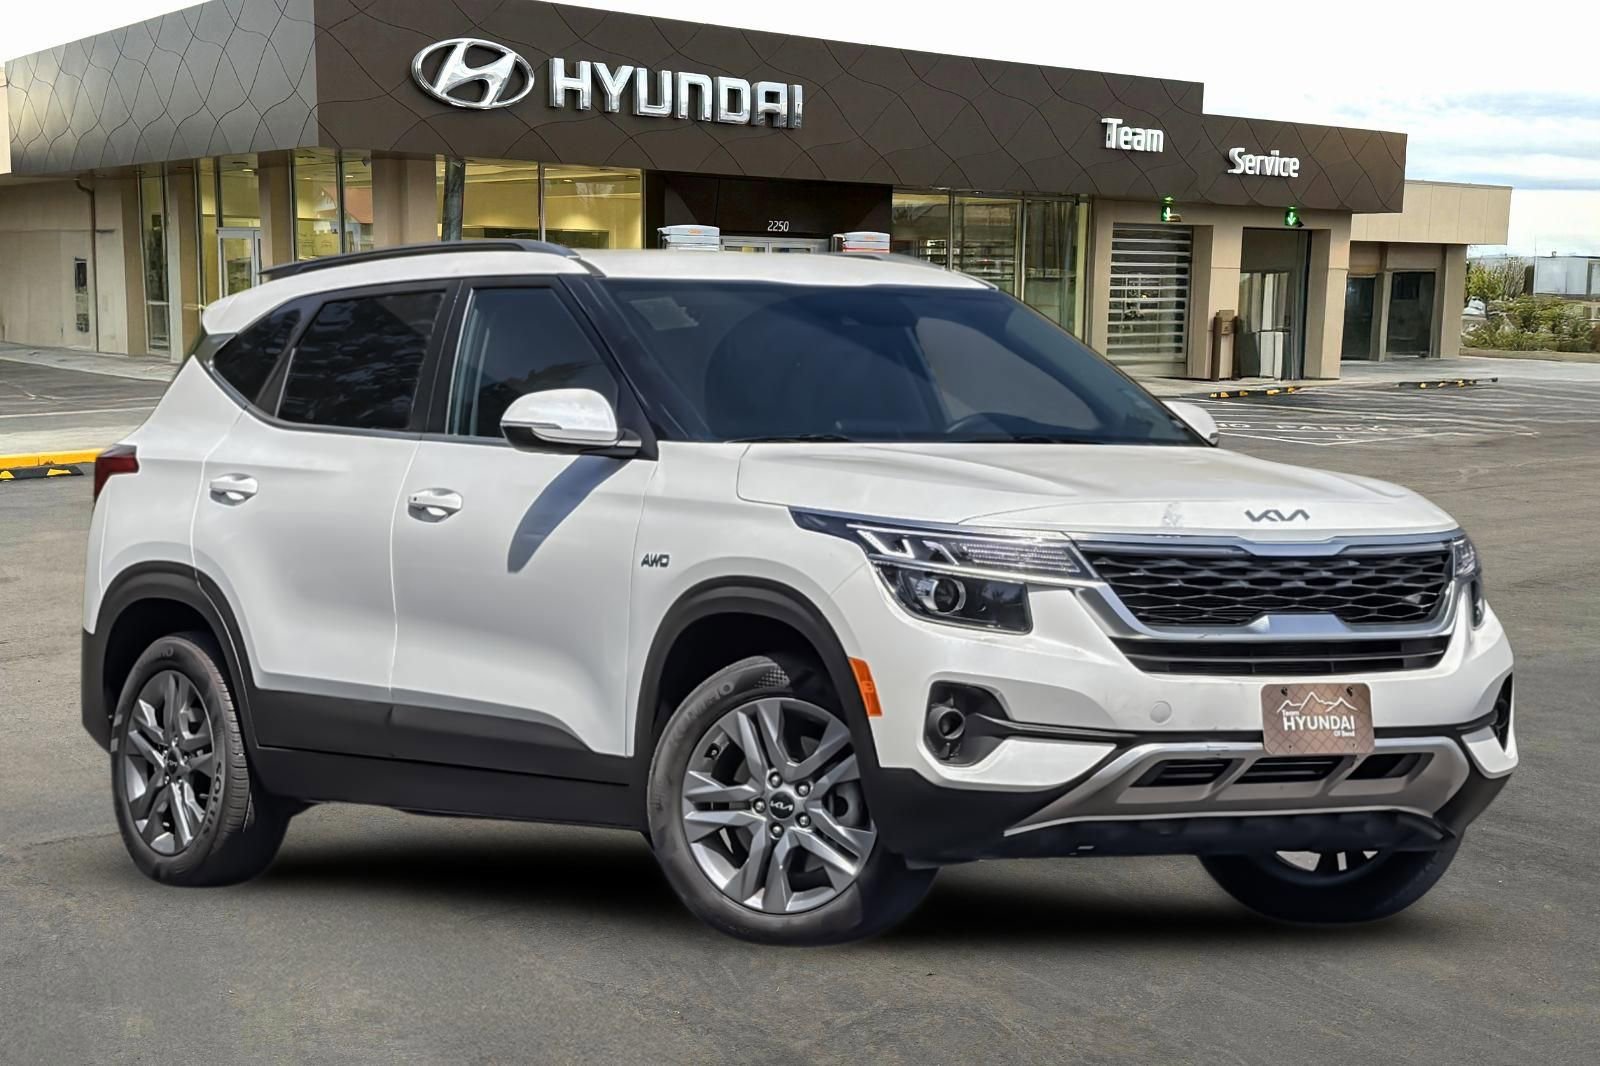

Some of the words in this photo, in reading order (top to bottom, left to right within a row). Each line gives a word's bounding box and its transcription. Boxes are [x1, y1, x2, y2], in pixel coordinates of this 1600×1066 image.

[549, 57, 803, 129] HYUNDAI
[1101, 117, 1164, 152] Team
[1227, 147, 1300, 178] Service
[767, 220, 790, 232] 2250
[641, 553, 670, 568] AWD
[1283, 715, 1355, 730] HYUNDAI
